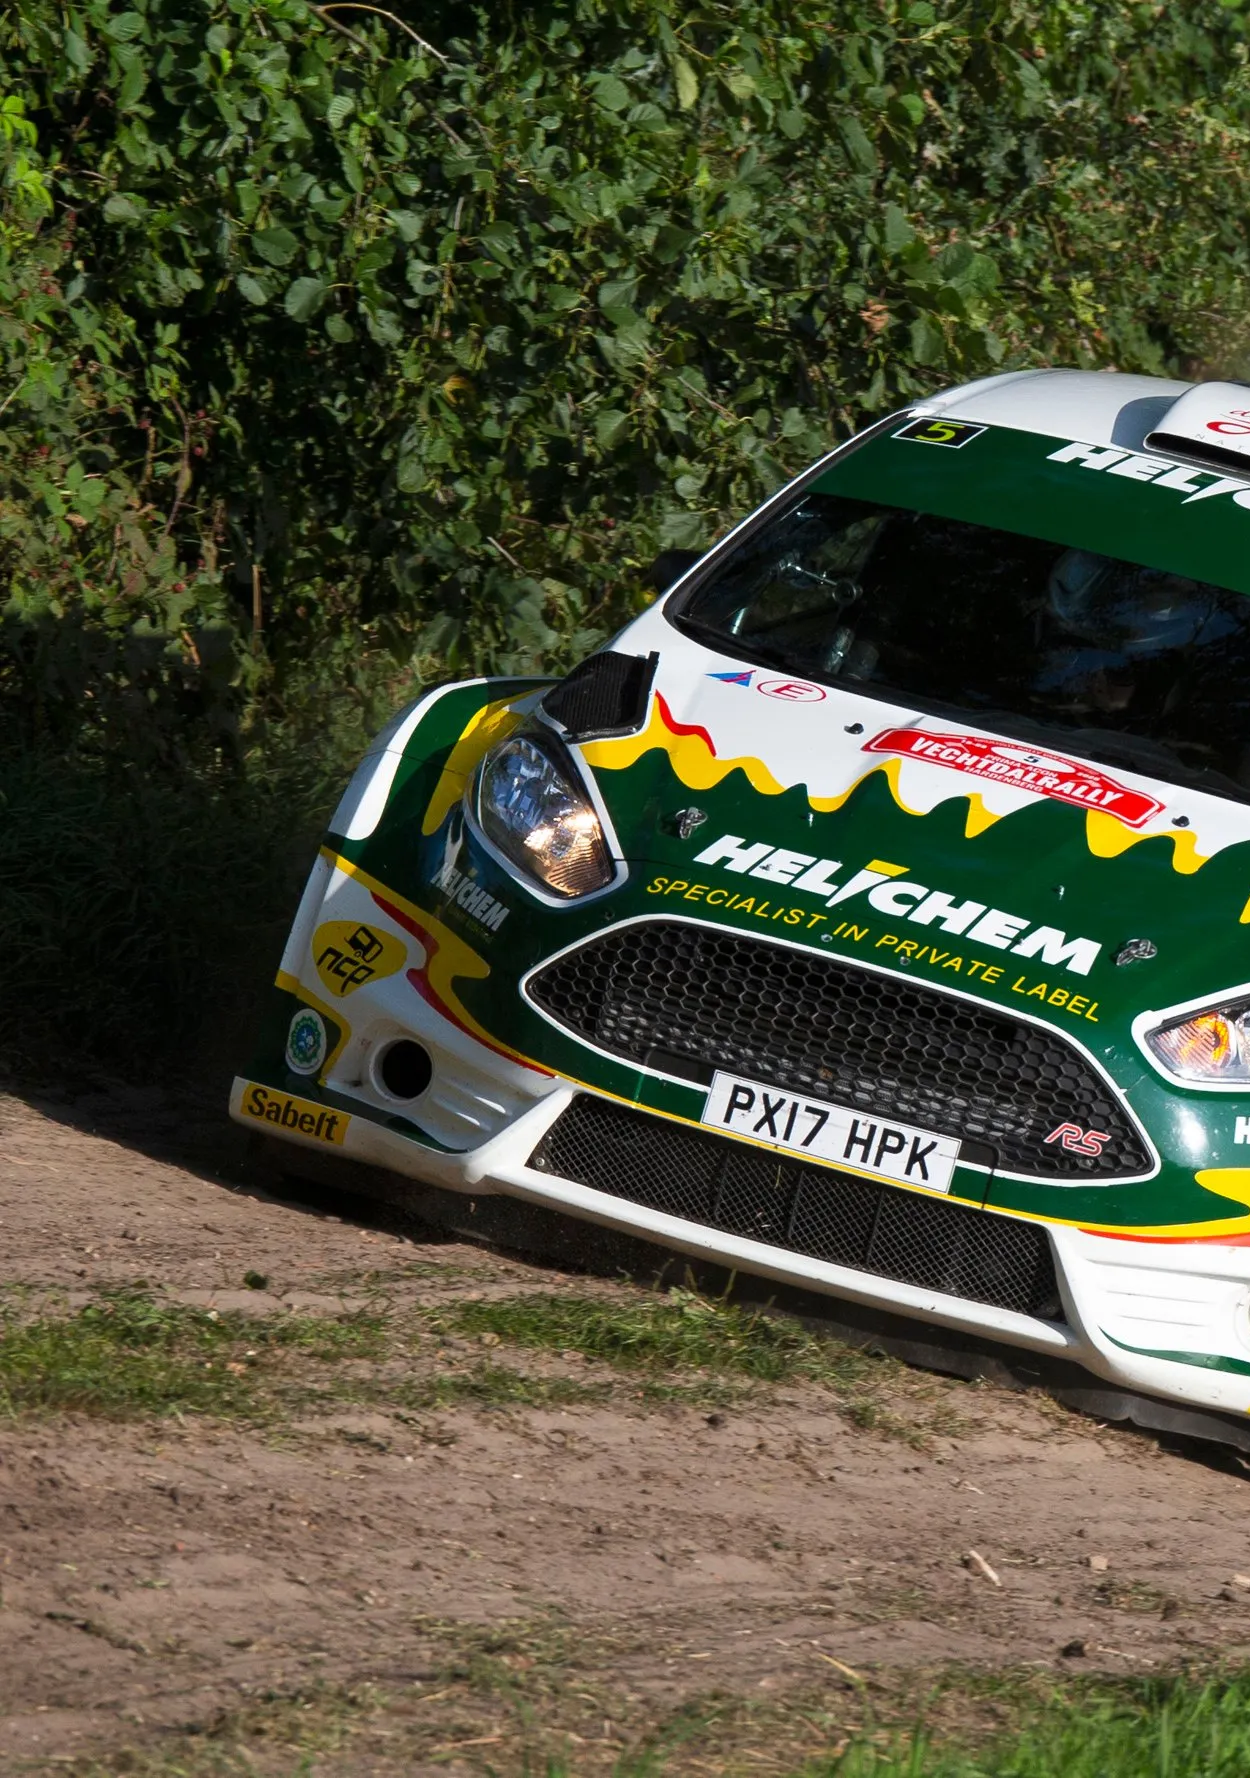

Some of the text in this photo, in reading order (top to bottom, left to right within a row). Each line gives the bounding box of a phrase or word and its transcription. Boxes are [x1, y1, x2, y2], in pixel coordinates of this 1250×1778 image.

[915, 421, 965, 442] 5
[910, 737, 1124, 806] VECHTDALRALLY
[964, 765, 1044, 792] HARDENBERG
[1023, 755, 1040, 764] 5
[693, 834, 1103, 977] HELICHEM
[316, 946, 375, 993] ncp
[646, 876, 1101, 1023] SPECIALIST IN PRIVATE LABEL
[247, 1088, 339, 1142] Sabelt
[722, 1083, 939, 1182] PX17 HPK
[1043, 1122, 1111, 1158] RS
